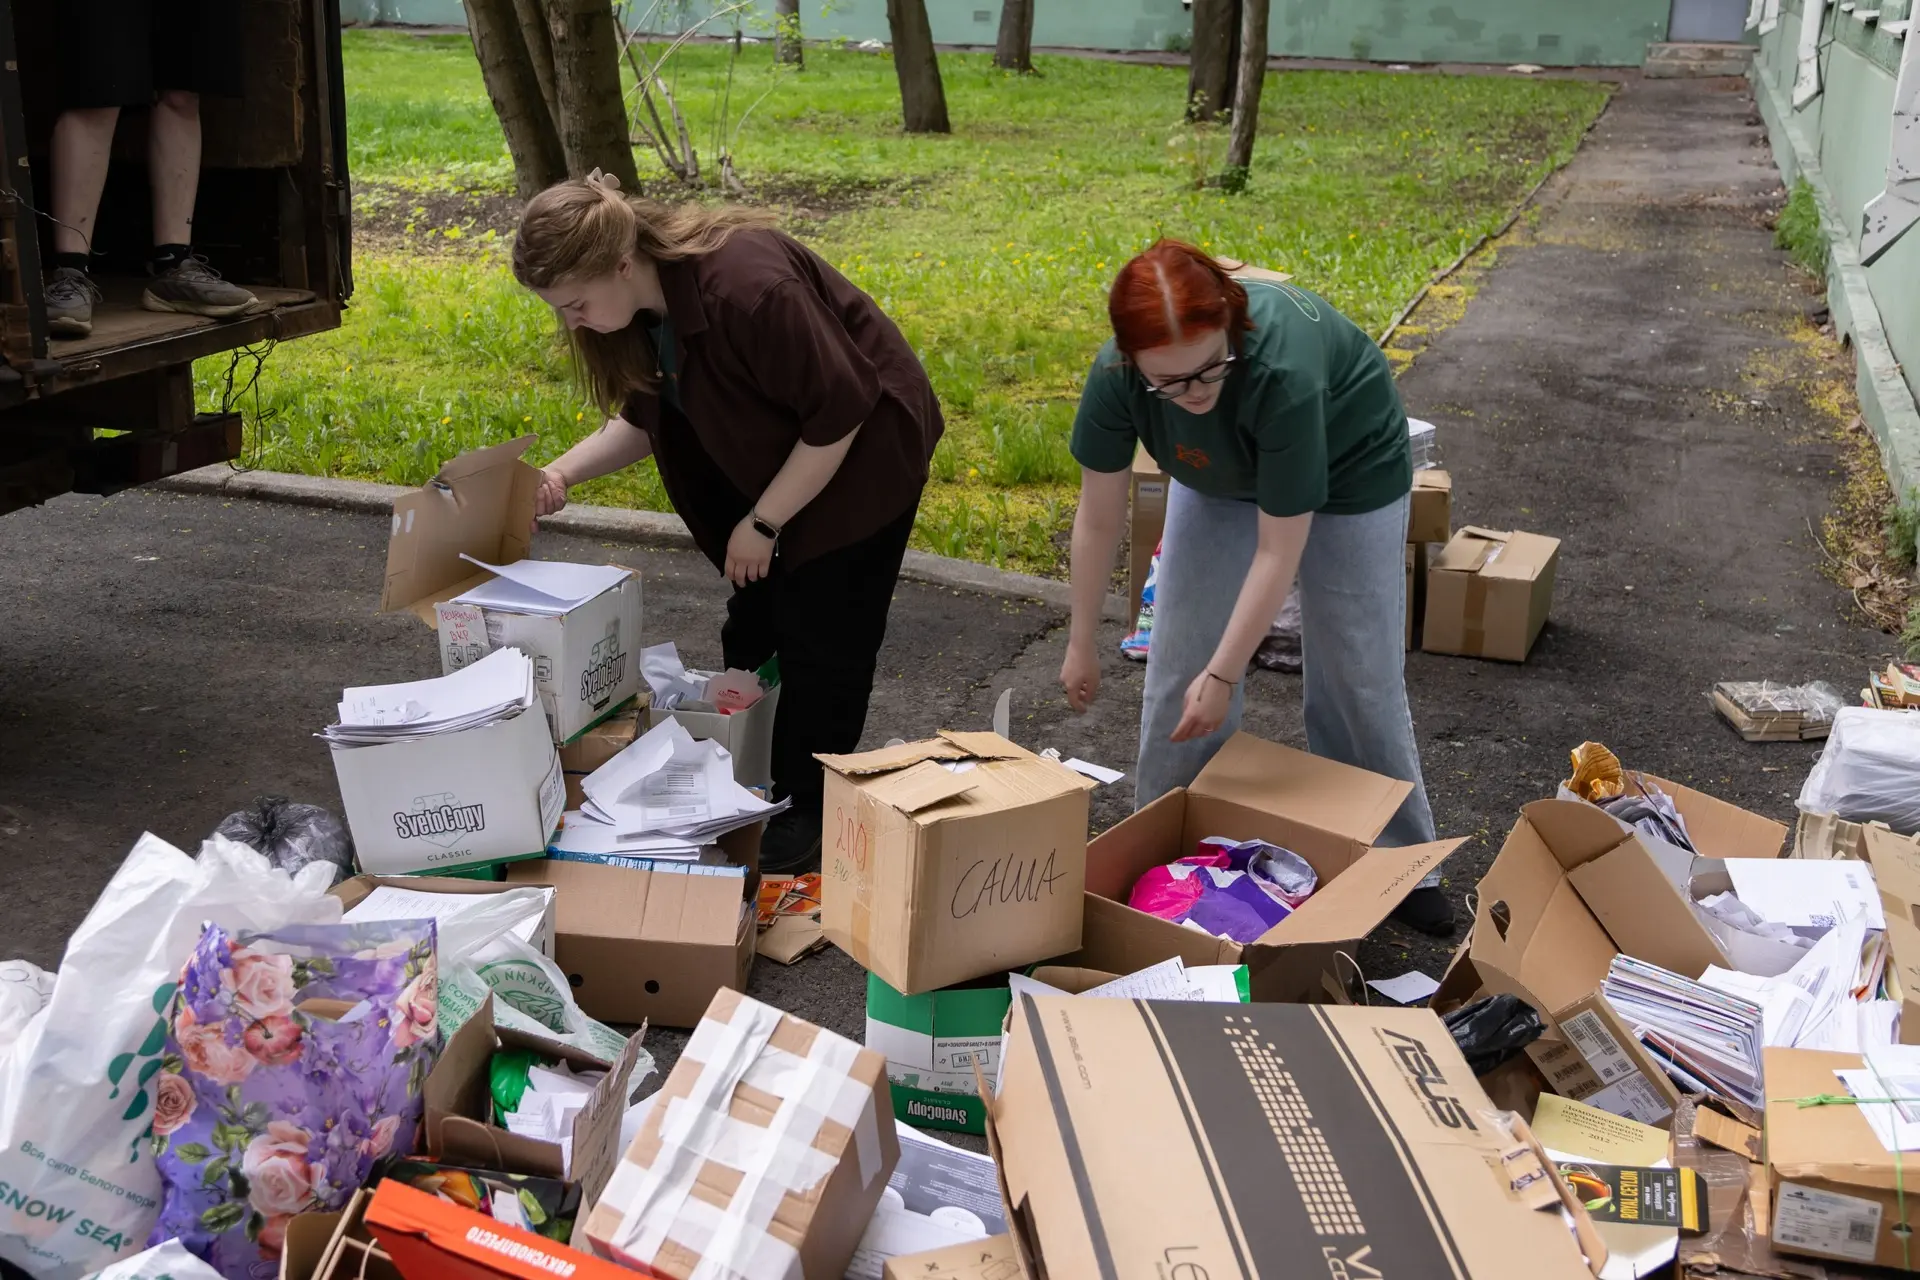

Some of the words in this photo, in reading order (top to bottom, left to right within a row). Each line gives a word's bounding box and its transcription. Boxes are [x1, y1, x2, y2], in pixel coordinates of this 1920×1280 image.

[580, 652, 627, 701] SvetoCopy
[393, 803, 486, 839] SvetoCopy
[427, 849, 473, 862] CLASSIC
[951, 848, 1069, 919] САША
[1381, 1027, 1479, 1132] ASUS
[907, 1100, 967, 1125] SvetoCopy
[20, 1140, 45, 1161] Вся
[46, 1157, 78, 1176] сила
[79, 1169, 125, 1196] Белого
[125, 1190, 157, 1209] моря
[1620, 1170, 1638, 1196] CEYLON
[1620, 1196, 1638, 1219] ROYAL
